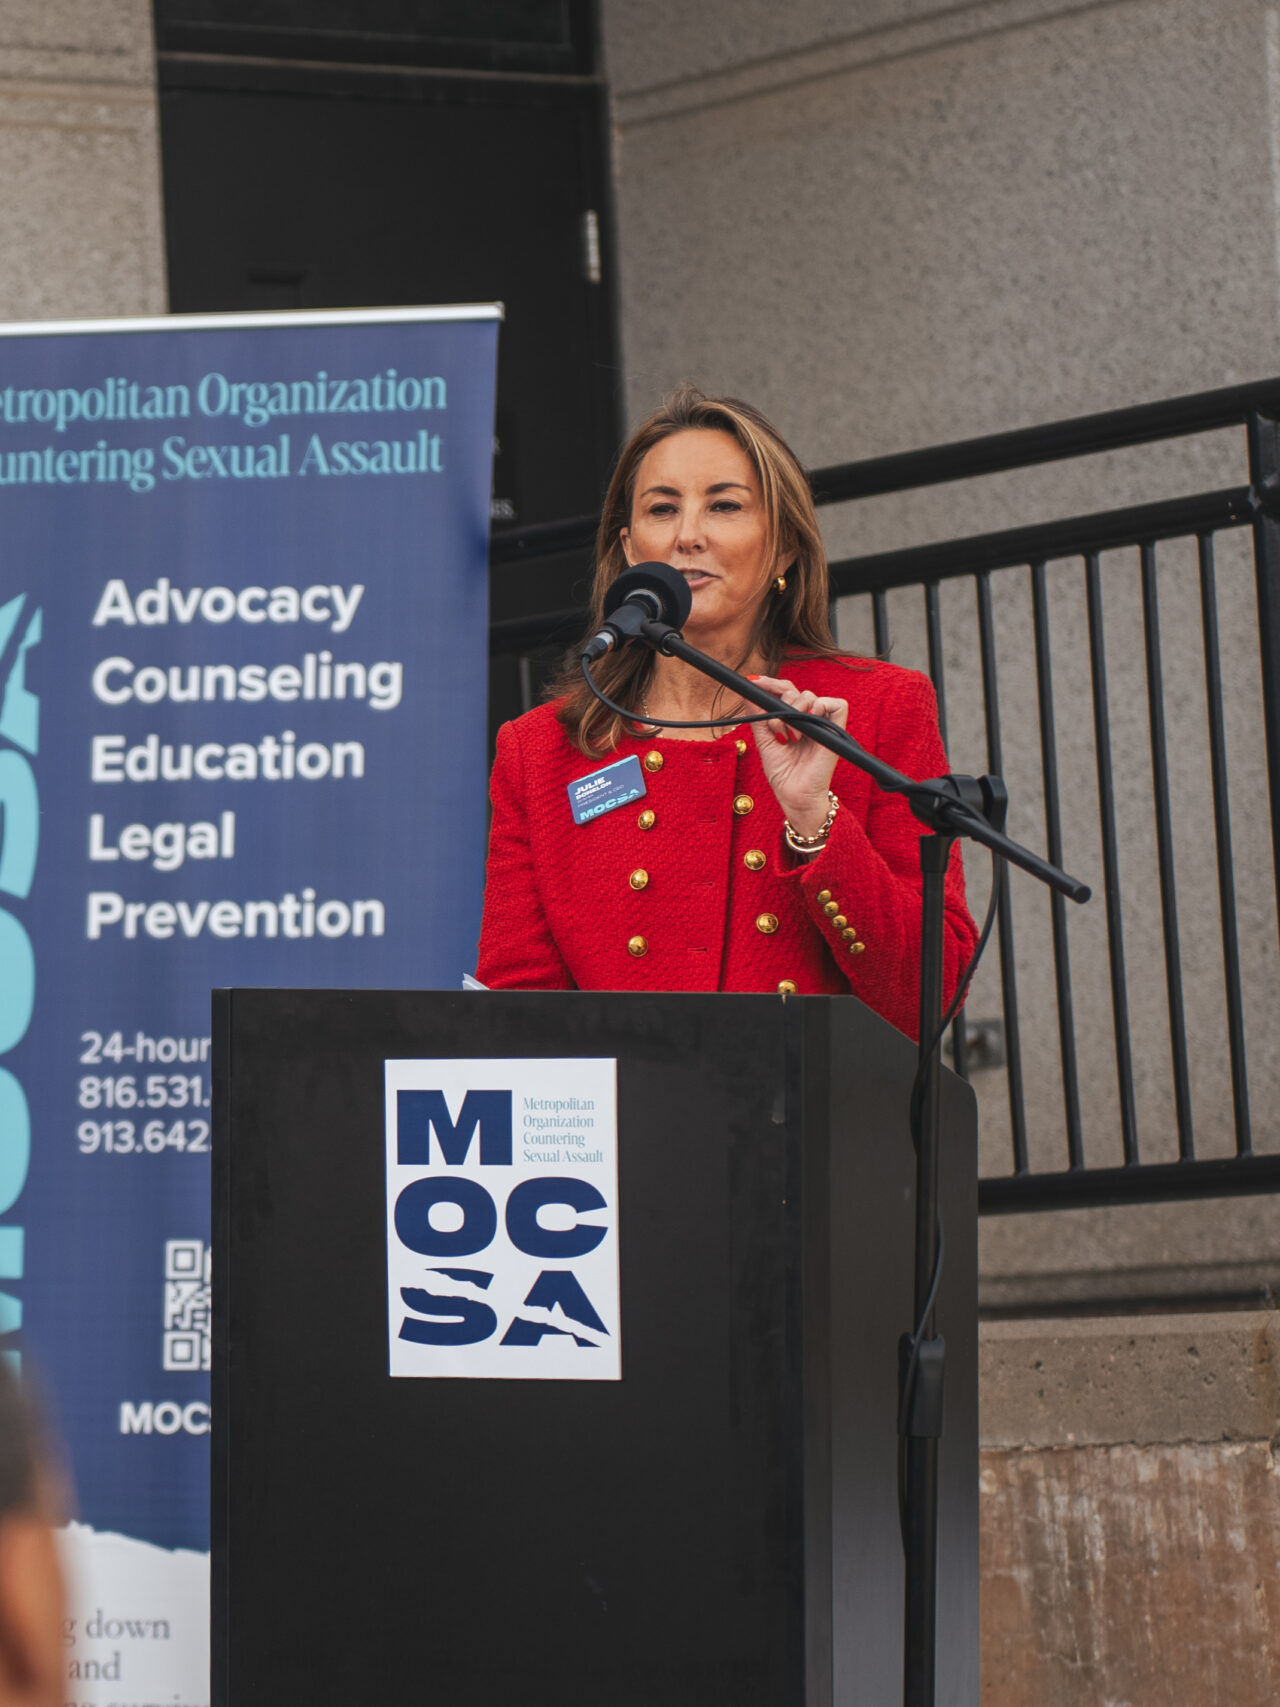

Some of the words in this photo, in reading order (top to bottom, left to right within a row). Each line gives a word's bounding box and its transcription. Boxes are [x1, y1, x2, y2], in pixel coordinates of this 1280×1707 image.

[198, 369, 448, 427] Organization
[162, 435, 291, 481] Sexual
[297, 430, 445, 476] Assault
[92, 577, 365, 633] Advocacy
[92, 650, 404, 710] Counseling
[91, 730, 366, 782] Education
[574, 776, 606, 796] JULIE
[579, 788, 640, 821] MOCSA
[89, 811, 236, 870] Legal
[86, 887, 386, 939] Prevention
[79, 1030, 212, 1064] 24-hour
[78, 1075, 212, 1109] 816.531.
[523, 1097, 595, 1113] Metropolitan
[77, 1120, 212, 1154] 913.642
[396, 1089, 513, 1166] M
[523, 1115, 595, 1131] Organization
[523, 1131, 586, 1148] Countering
[523, 1149, 560, 1163] Sexual
[562, 1149, 604, 1163] Assault
[120, 1401, 211, 1435] MOC
[86, 1608, 171, 1640] down
[68, 1650, 122, 1682] and
